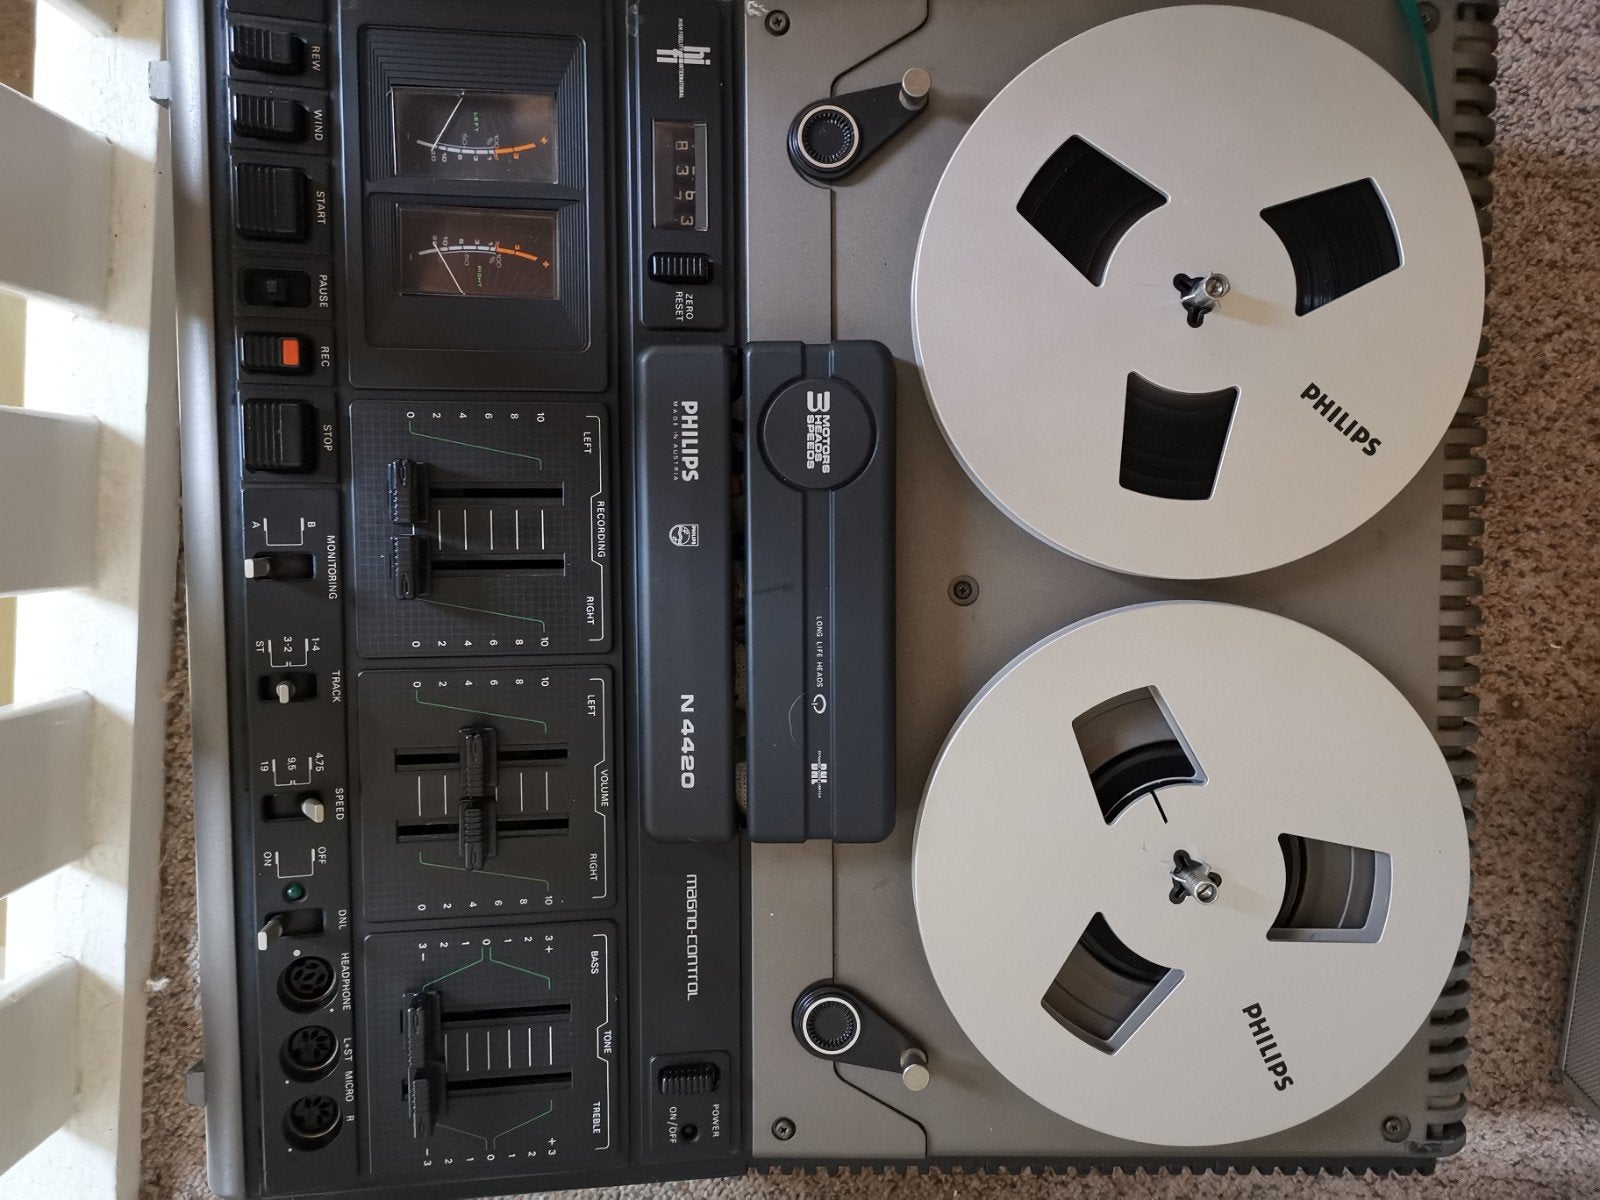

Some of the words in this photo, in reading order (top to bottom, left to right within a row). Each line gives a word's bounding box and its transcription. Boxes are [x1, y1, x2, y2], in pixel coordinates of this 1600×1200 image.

[311, 46, 320, 72] REW
[684, 46, 710, 65] hi
[314, 110, 323, 141] WIND
[316, 191, 326, 224] START
[318, 274, 328, 308] PAUSE
[320, 346, 330, 367] REC
[807, 391, 830, 412] 3
[537, 413, 544, 422] 10
[1300, 383, 1382, 456] PHILIPS
[323, 424, 333, 451] STOP
[583, 432, 592, 454] LEFT
[681, 401, 699, 481] PHILIPS
[822, 415, 830, 473] MOTORS
[596, 501, 605, 558] RECORDING
[327, 535, 337, 600] MONITORING
[586, 596, 595, 625] RIGHT
[255, 640, 264, 653] ST
[283, 636, 292, 652] 3-2
[311, 638, 320, 651] 1-4
[540, 637, 548, 647] 10
[332, 671, 341, 703] TRACK
[541, 677, 549, 686] 10
[587, 695, 596, 716] LEFT
[681, 695, 694, 712] N
[287, 757, 296, 770] 9.5
[314, 752, 324, 772] 4.75
[681, 719, 695, 789] 4420
[260, 761, 269, 772] 19
[600, 770, 608, 807] VOLUME
[335, 788, 344, 820] SPEED
[263, 852, 272, 866] ON
[317, 846, 326, 864] OFF
[589, 854, 597, 881] RIGHT
[545, 896, 553, 905] 10
[338, 909, 347, 930] DNL
[591, 951, 599, 974] BASS
[340, 953, 351, 1010] HEADPHONE
[344, 1038, 353, 1061] L+ST
[1242, 1003, 1294, 1091] PHILIPS
[344, 1071, 354, 1102] MICRO
[592, 1102, 600, 1134] TREBLE
[667, 1107, 678, 1144] ON/OFF
